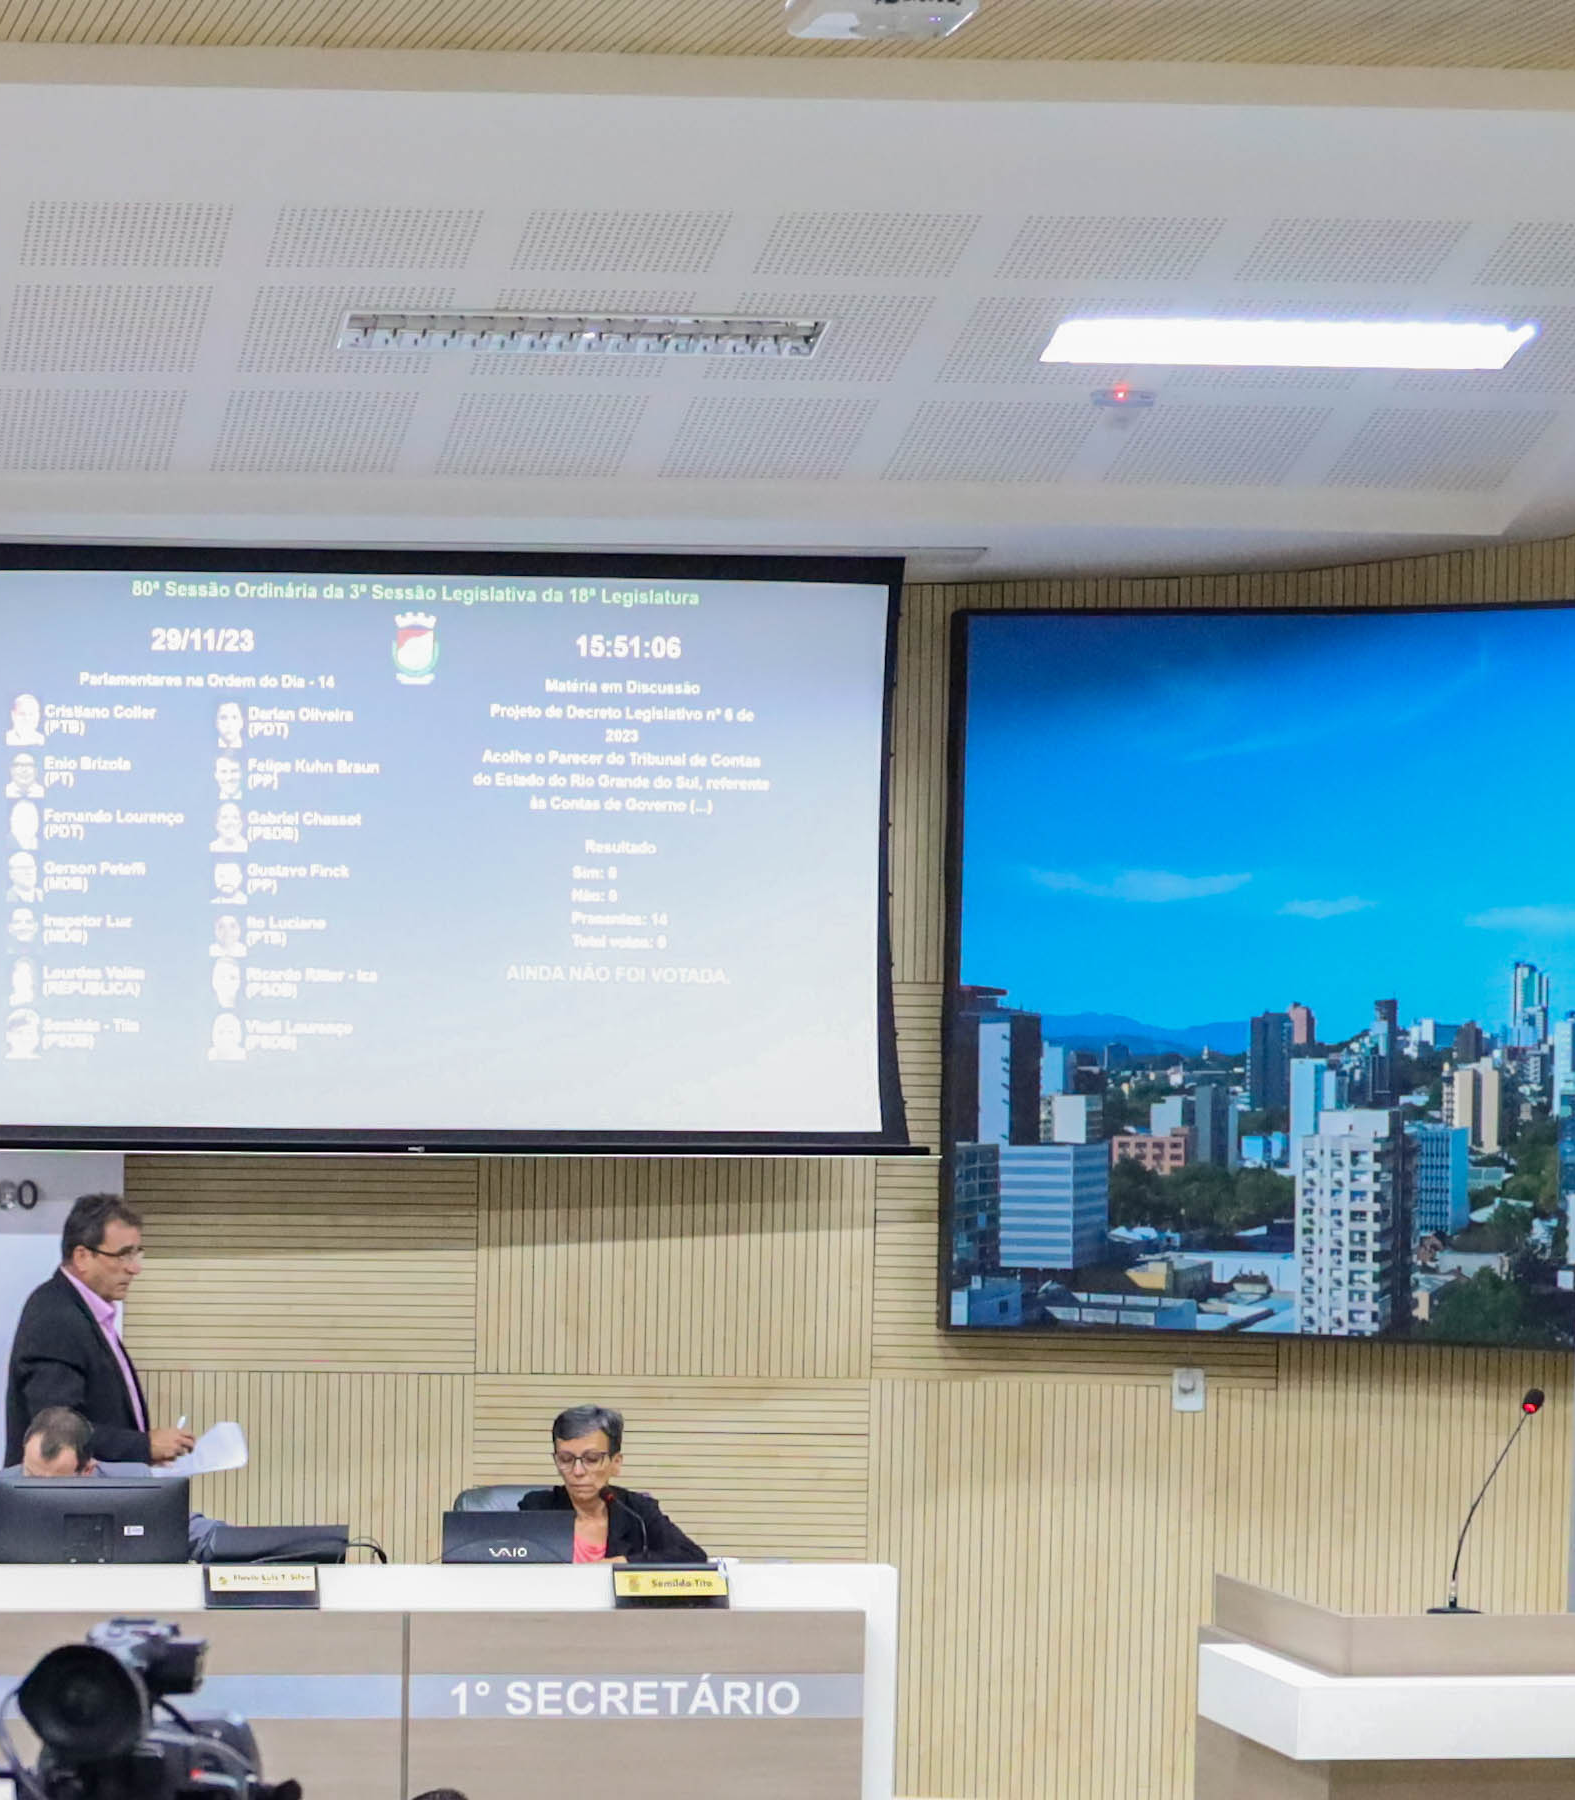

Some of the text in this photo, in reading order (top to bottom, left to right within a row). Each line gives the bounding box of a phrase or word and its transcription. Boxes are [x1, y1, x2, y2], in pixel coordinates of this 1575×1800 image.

[164, 580, 230, 599] Sessão
[234, 581, 318, 601] Ordinária
[322, 584, 345, 602] da
[371, 583, 438, 603] Sessão
[442, 584, 537, 608] Legislativa
[540, 586, 565, 604] da
[601, 587, 700, 609] Legislatura
[151, 628, 255, 652] 29/11/23
[575, 635, 682, 659] 15:51:06
[319, 676, 335, 690] 14
[488, 1546, 528, 1558] VAIO
[505, 1673, 801, 1717] SECRETÁRIO
